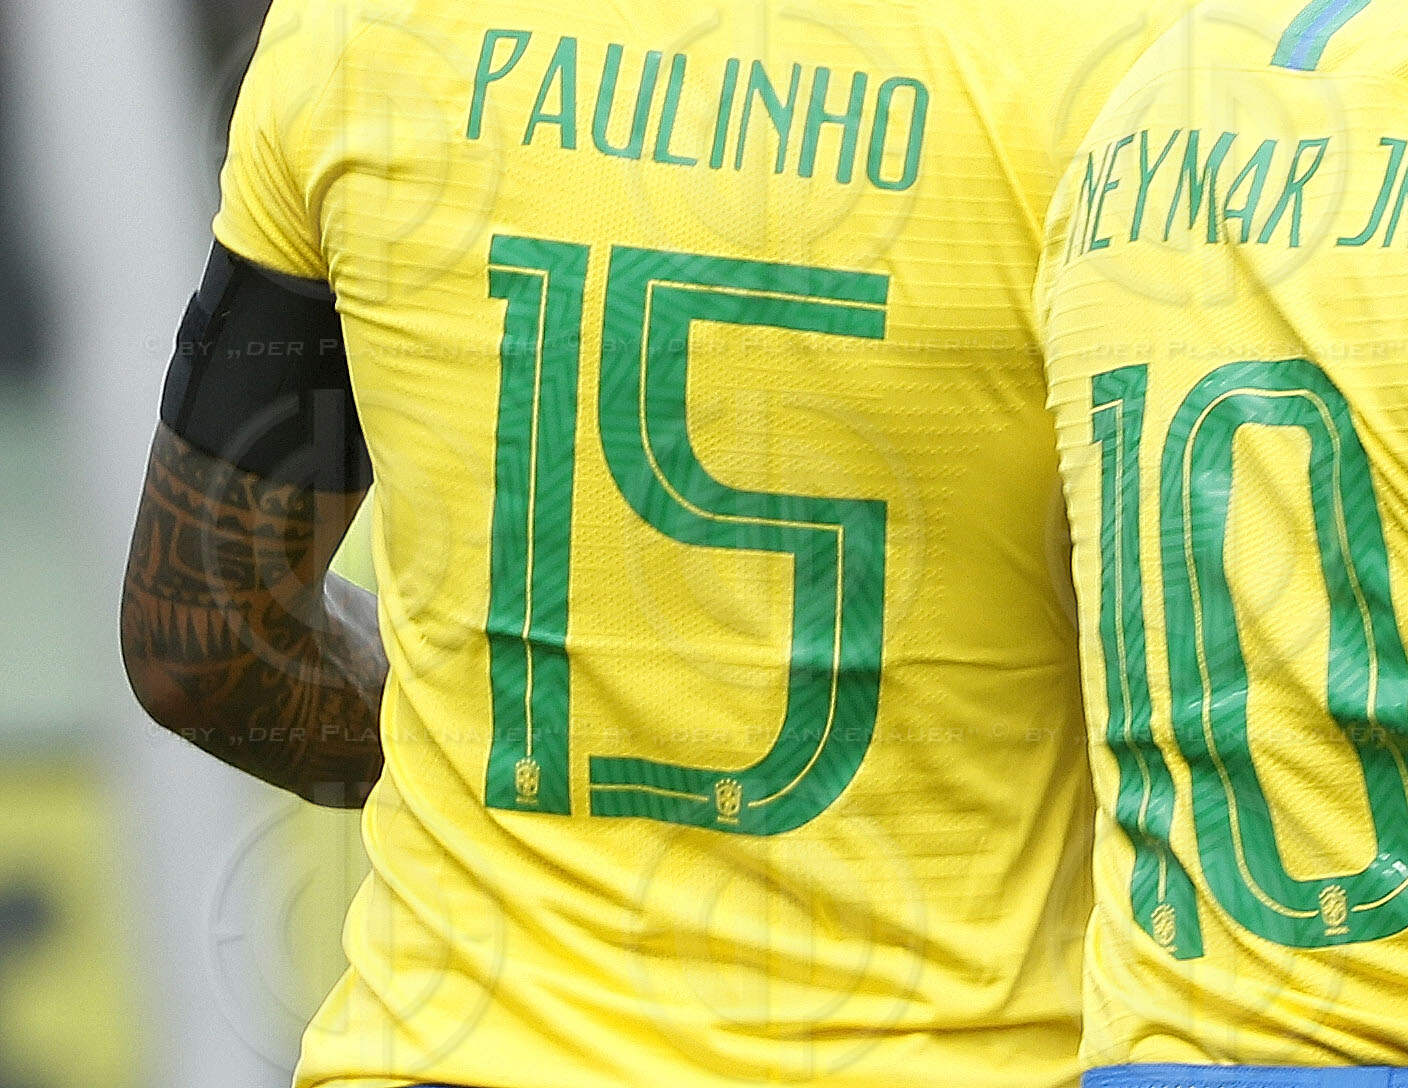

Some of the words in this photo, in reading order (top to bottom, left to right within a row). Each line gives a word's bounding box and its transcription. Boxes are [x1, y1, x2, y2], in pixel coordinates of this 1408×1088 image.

[465, 28, 930, 191] PAULINHO
[1063, 127, 1332, 266] NEYMAR
[485, 234, 890, 836] 15
